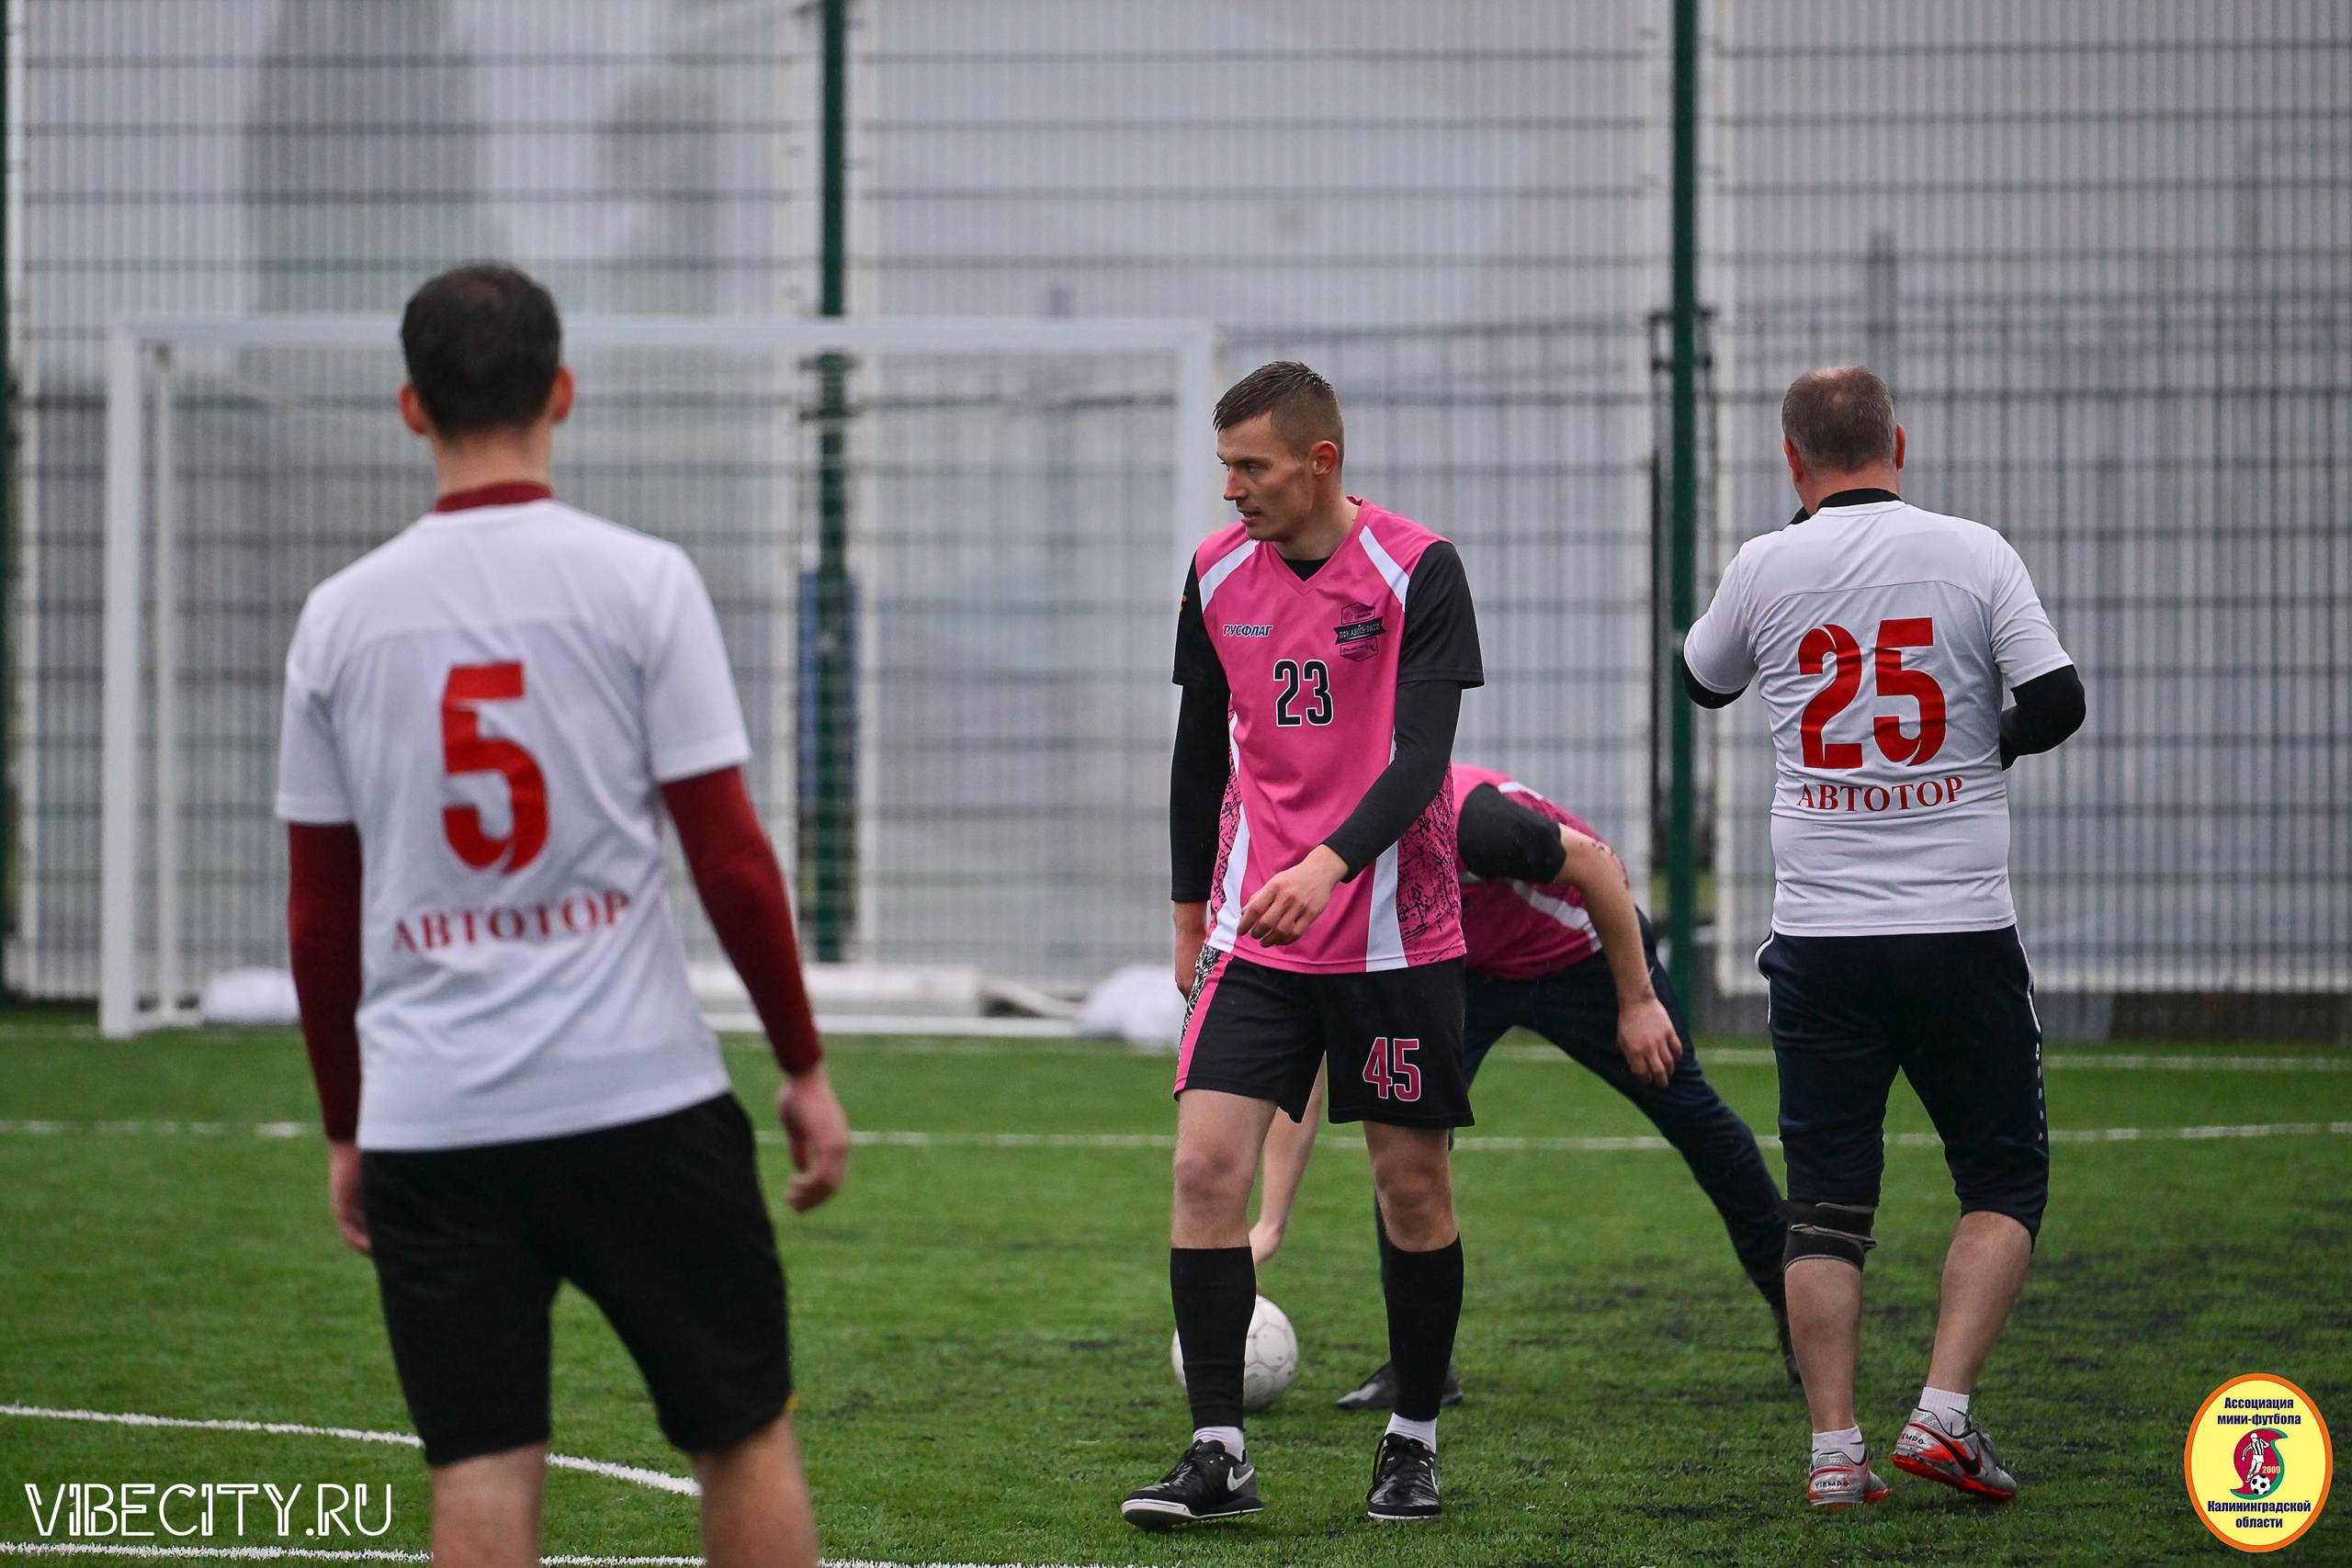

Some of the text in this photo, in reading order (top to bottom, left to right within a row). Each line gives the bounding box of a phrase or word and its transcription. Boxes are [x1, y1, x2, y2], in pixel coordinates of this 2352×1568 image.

[1223, 624, 1273, 637] РУСФЛАГ
[1272, 659, 1334, 728] 23
[1798, 616, 1947, 770] 25
[440, 660, 549, 877] 5
[1797, 776, 1963, 812] АВТОТОР
[392, 886, 631, 953] АВТОТОР
[1362, 1036, 1421, 1102] 45
